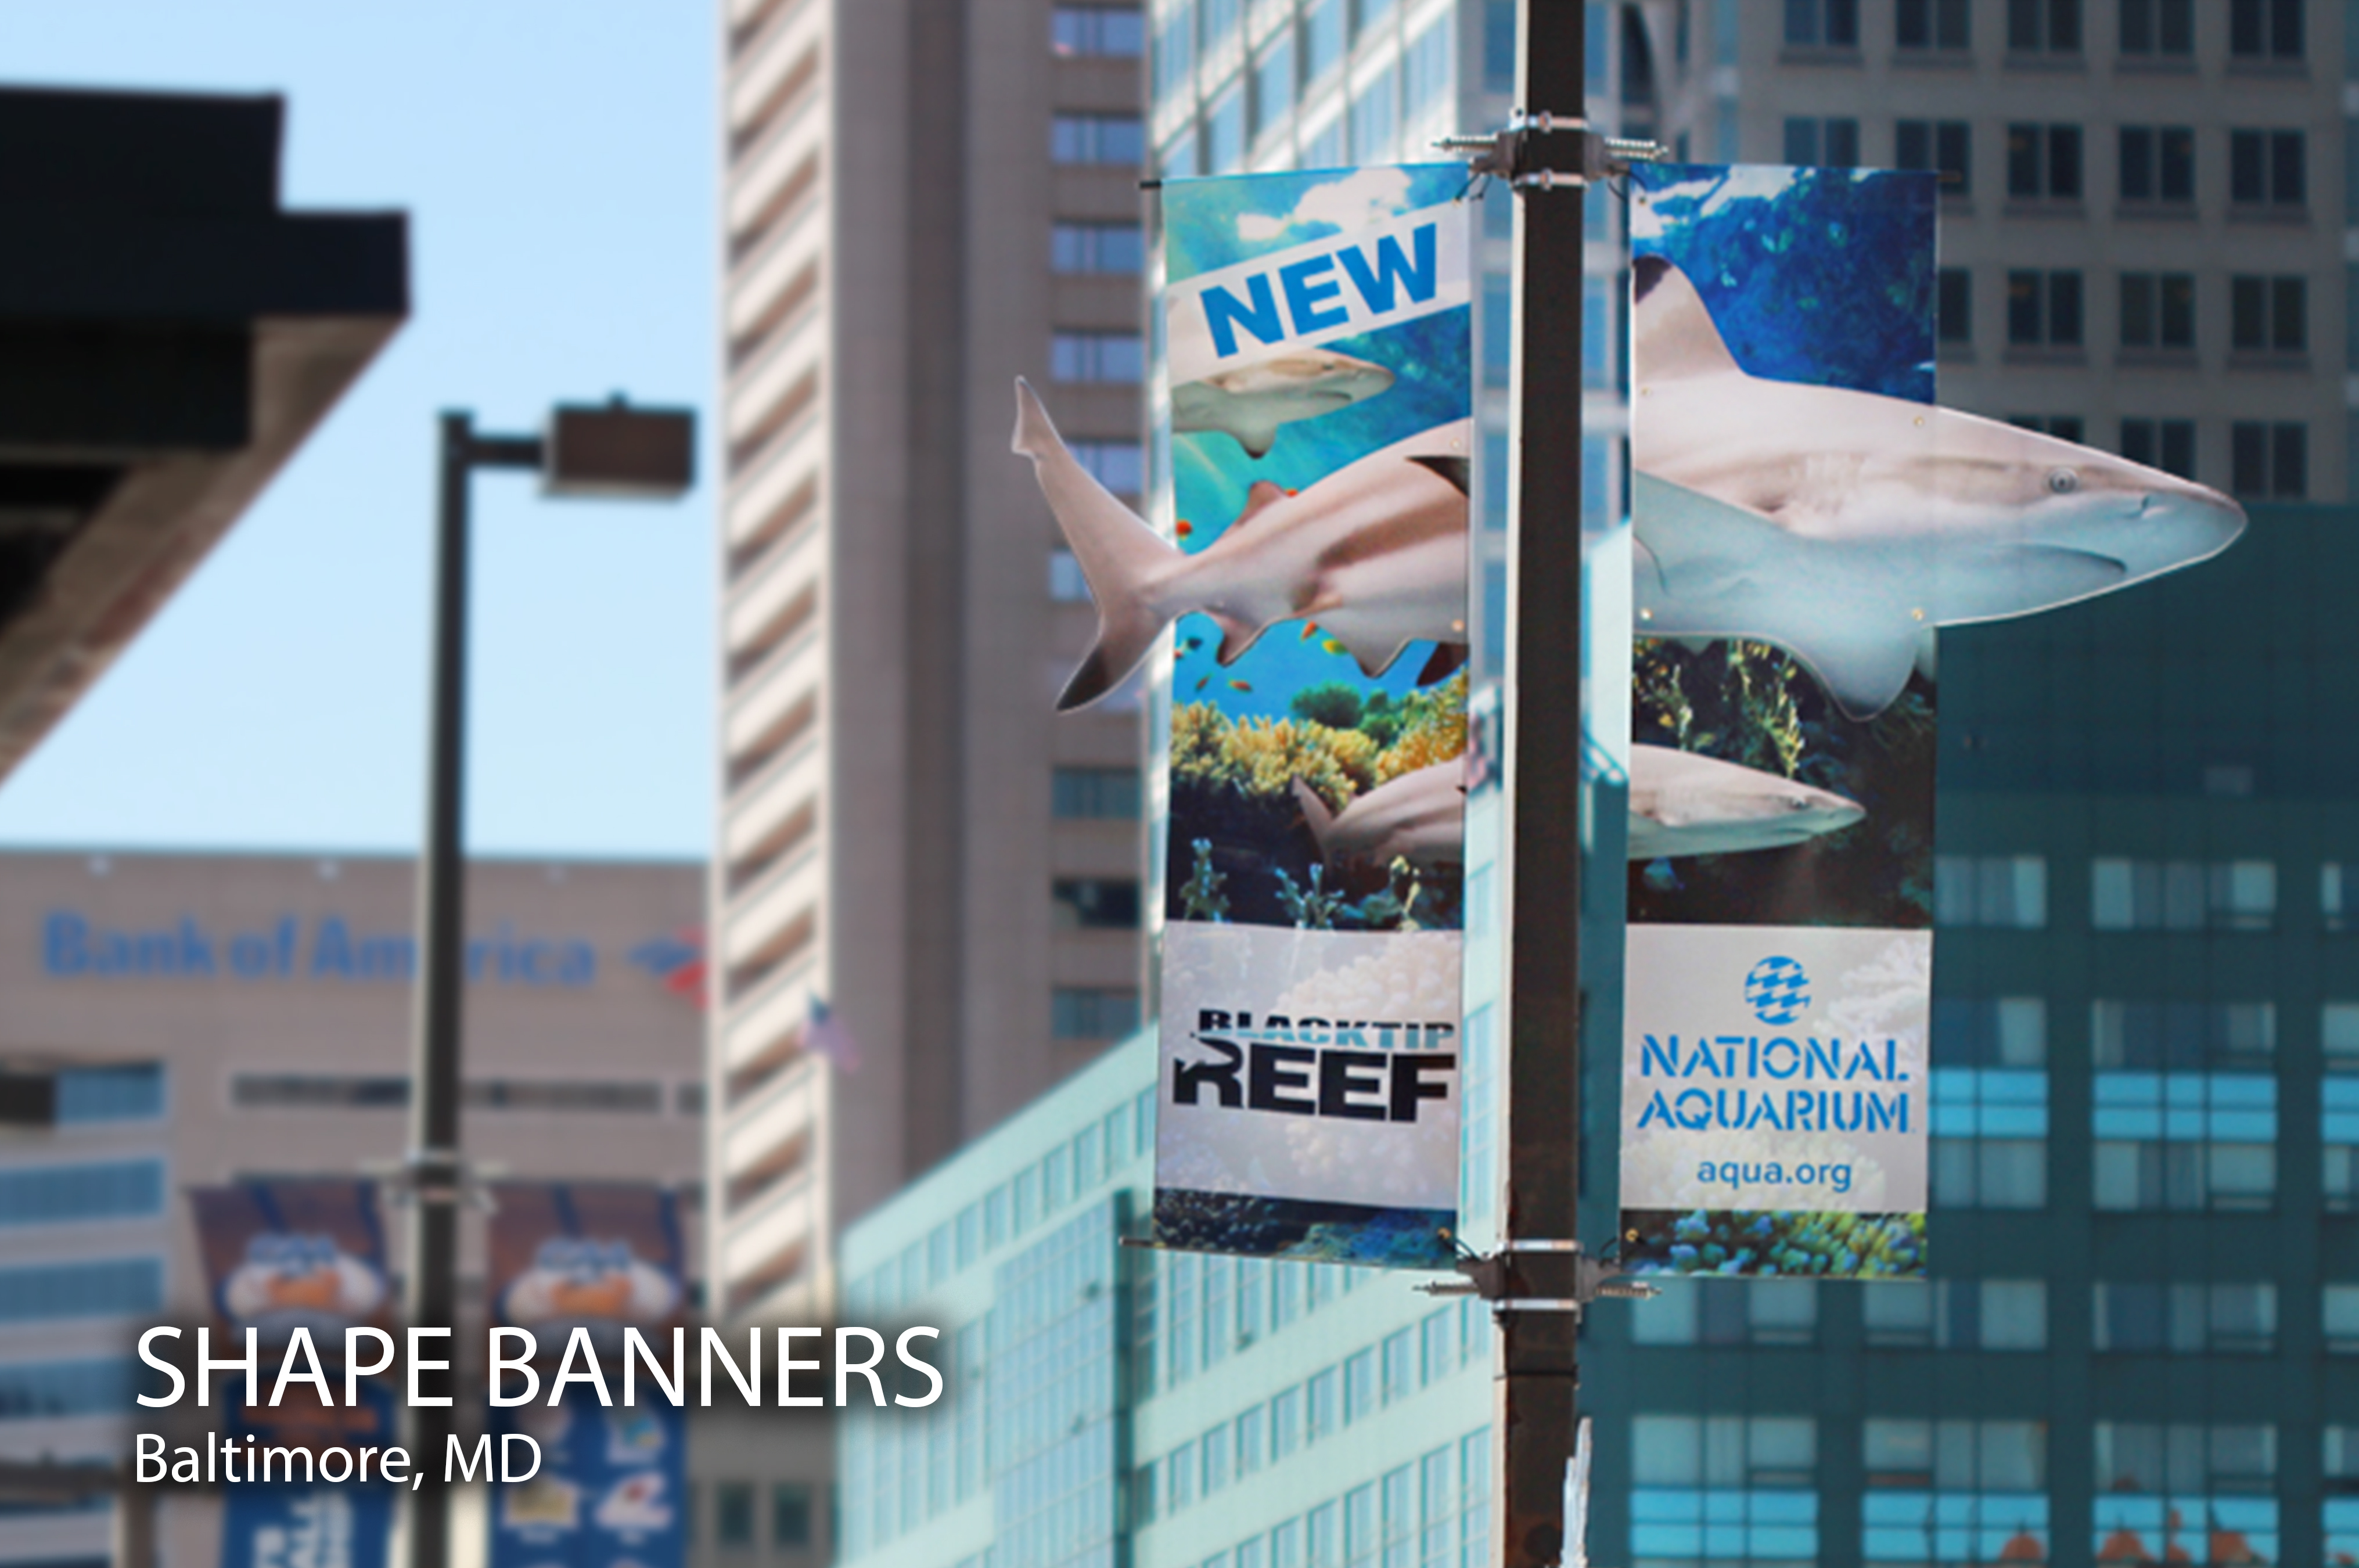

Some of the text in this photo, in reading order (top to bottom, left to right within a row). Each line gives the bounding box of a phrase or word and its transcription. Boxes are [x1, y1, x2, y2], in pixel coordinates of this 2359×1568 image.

[1199, 222, 1437, 359] NEW
[44, 912, 595, 986] Bank of Amrica
[1198, 1009, 1455, 1049] BLACKTIP
[1172, 1031, 1456, 1123] REEF
[1641, 1034, 1910, 1081] NATIONAL
[1637, 1087, 1910, 1134] AQUARIUM
[1697, 1161, 1853, 1194] aqua.org
